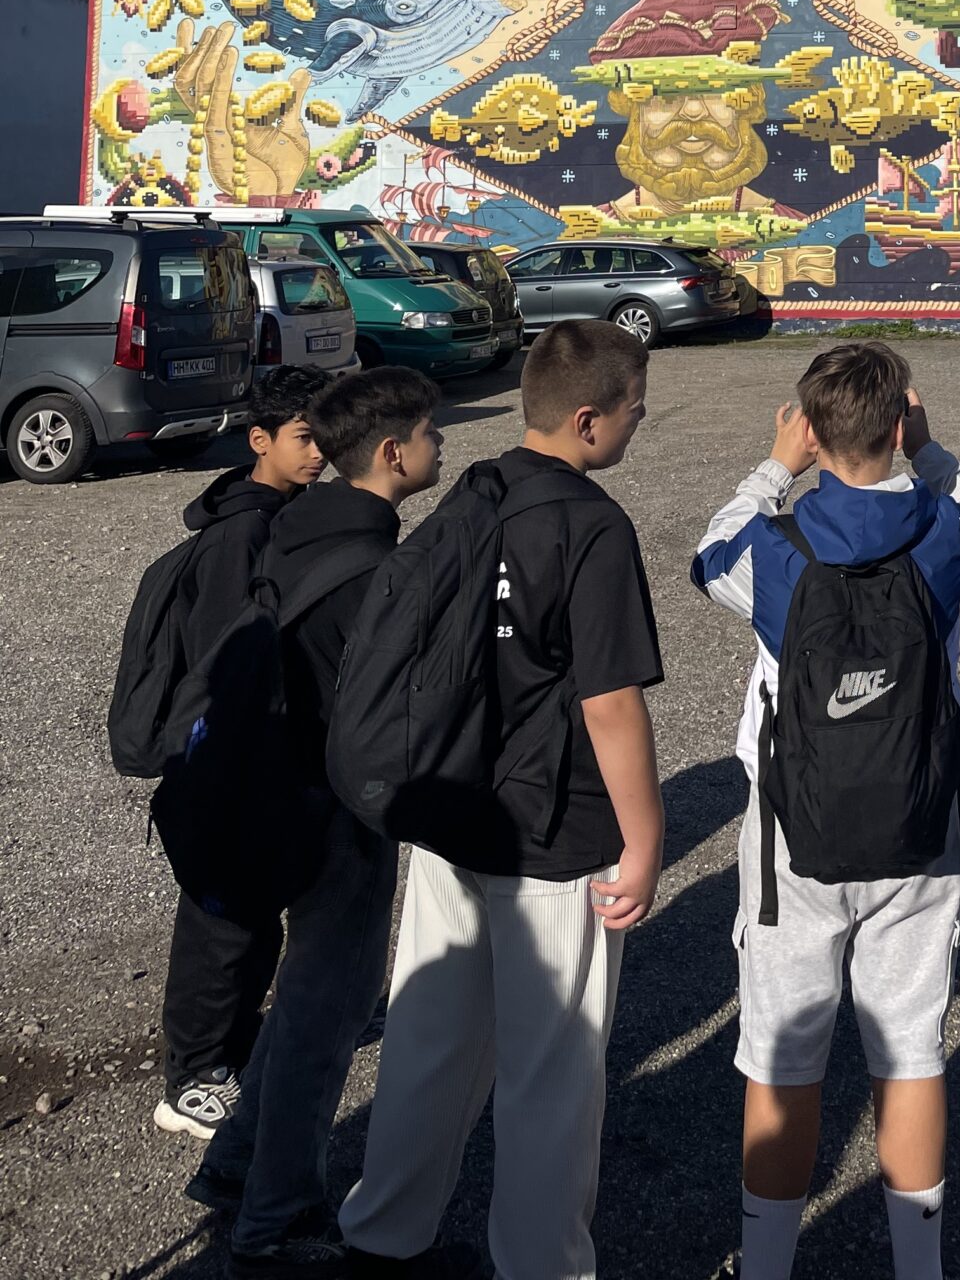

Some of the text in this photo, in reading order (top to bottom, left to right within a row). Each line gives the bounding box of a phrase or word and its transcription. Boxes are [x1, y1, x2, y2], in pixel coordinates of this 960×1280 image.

[173, 361, 184, 374] HH
[190, 360, 200, 372] KK
[837, 668, 886, 698] NIKE
